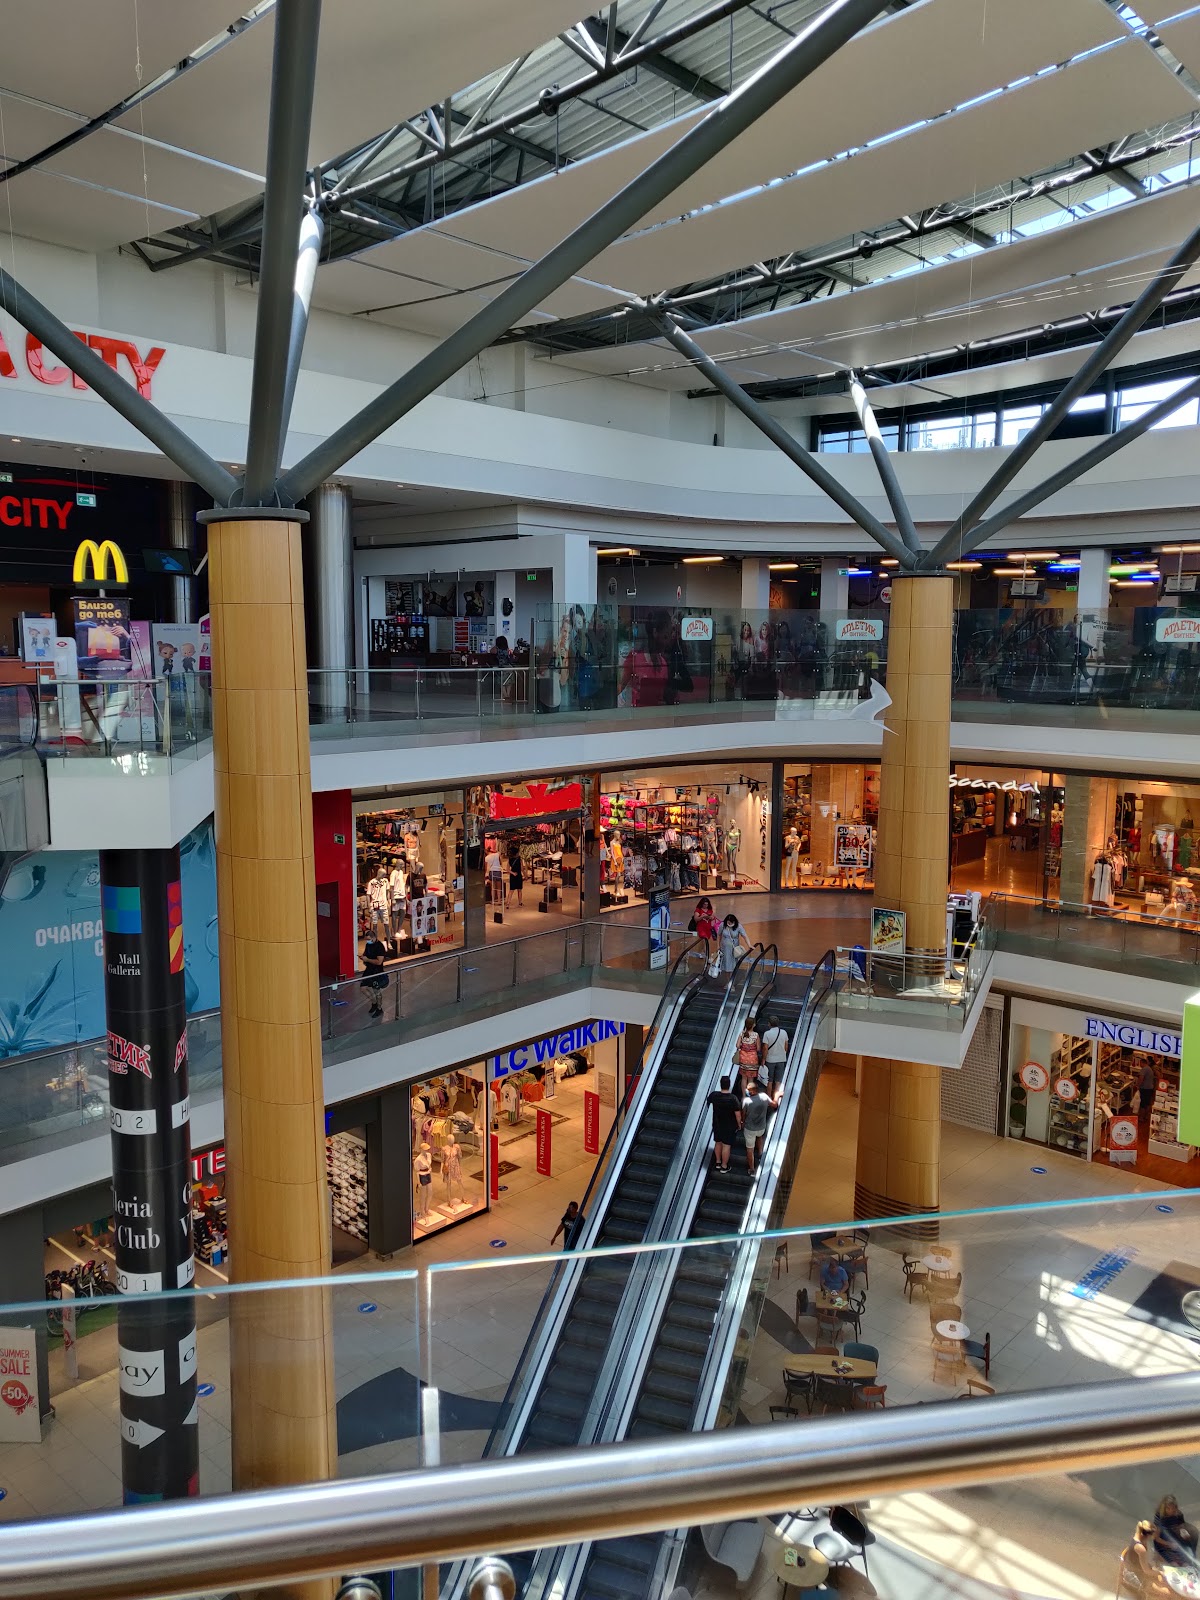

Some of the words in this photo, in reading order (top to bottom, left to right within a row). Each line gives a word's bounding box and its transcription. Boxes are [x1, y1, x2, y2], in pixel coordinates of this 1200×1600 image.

[26, 330, 167, 400] CTY
[0, 495, 74, 530] CITY
[841, 620, 876, 637] АТЛЕТИК
[949, 773, 1041, 794] Scandal
[118, 953, 140, 965] Mall
[107, 963, 142, 976] Galleria
[493, 1046, 531, 1078] LC
[135, 1116, 144, 1129] 2
[117, 1223, 160, 1249] Club
[142, 1279, 149, 1292] 1
[0, 1348, 30, 1359] SUMMER
[0, 1358, 31, 1376] SALE
